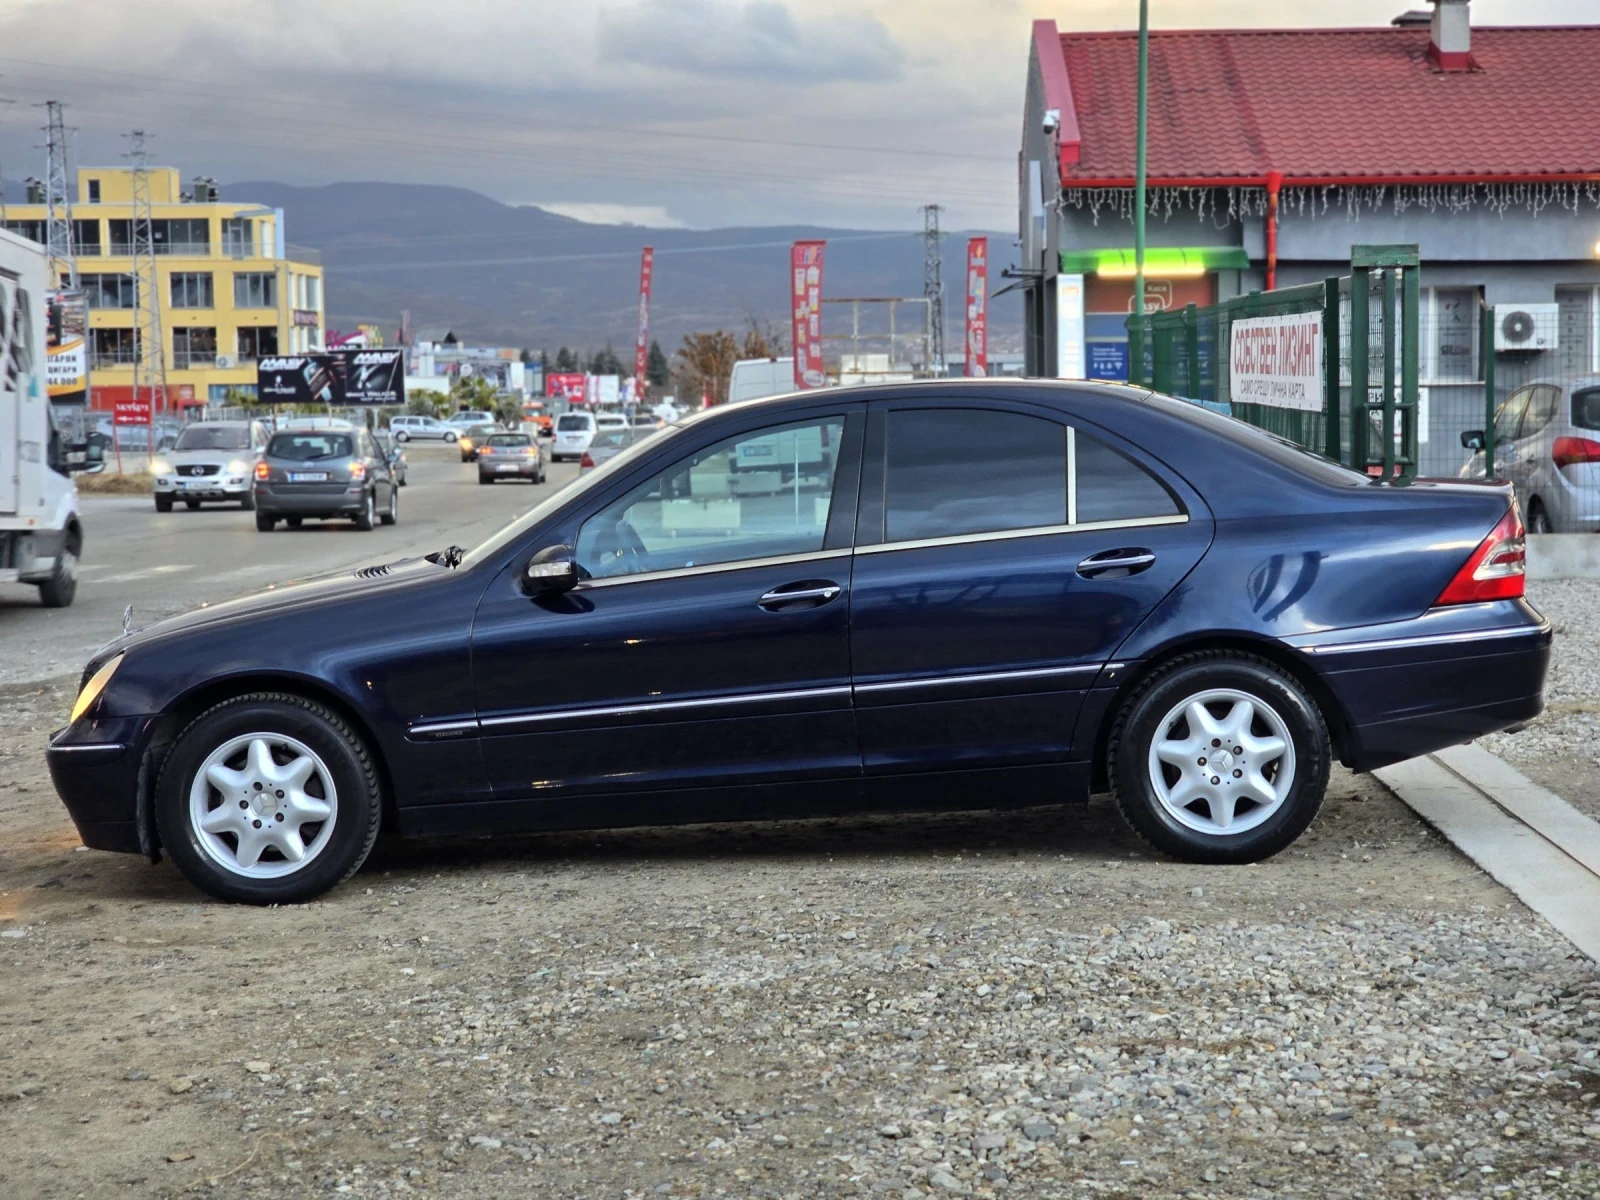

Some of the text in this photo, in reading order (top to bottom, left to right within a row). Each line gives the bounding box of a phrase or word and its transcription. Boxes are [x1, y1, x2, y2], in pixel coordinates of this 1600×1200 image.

[1234, 323, 1318, 377] СОБСТВЕН ЛИЗИНГ
[1240, 379, 1306, 400] САМО СРЕЩУ ЛИЧНА КАРТА
